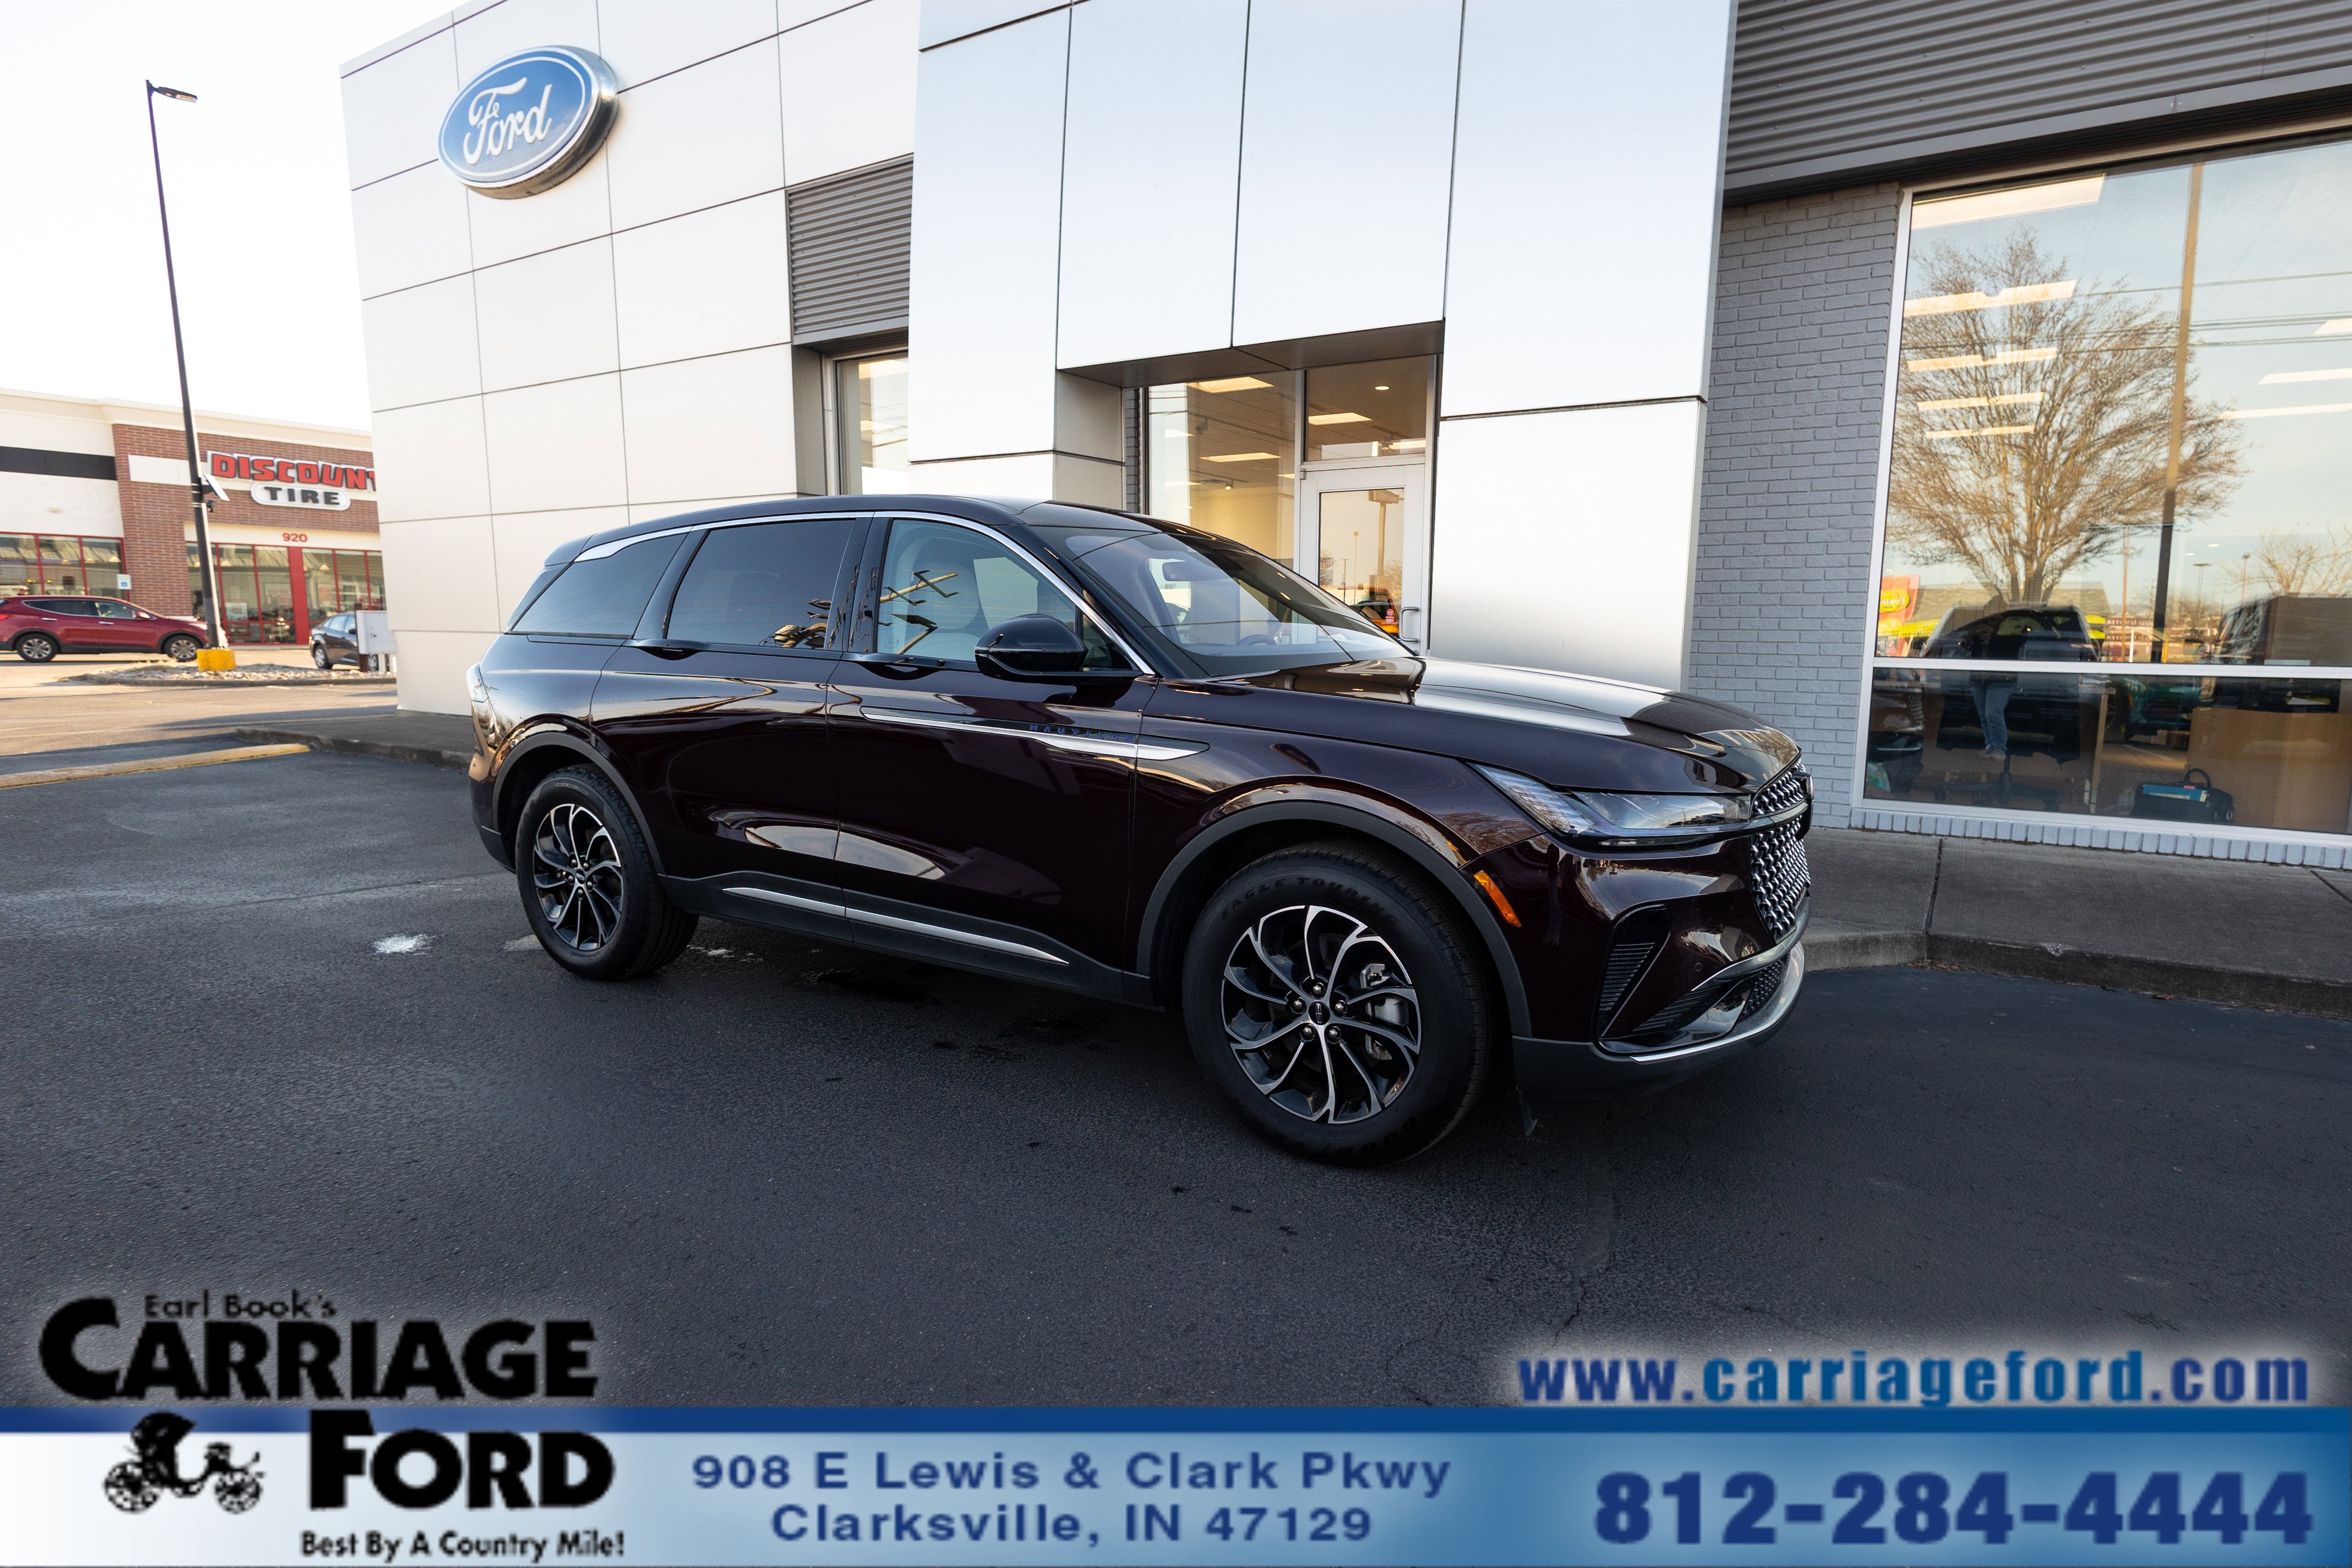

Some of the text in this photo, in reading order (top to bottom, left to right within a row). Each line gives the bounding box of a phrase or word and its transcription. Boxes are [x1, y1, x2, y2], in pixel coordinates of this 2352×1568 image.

[463, 77, 552, 165] Ford
[264, 486, 340, 505] TIRE
[282, 532, 308, 543] 920
[1030, 724, 1133, 742] NAUTILUS
[1221, 876, 1400, 925] EAGLE TOURING
